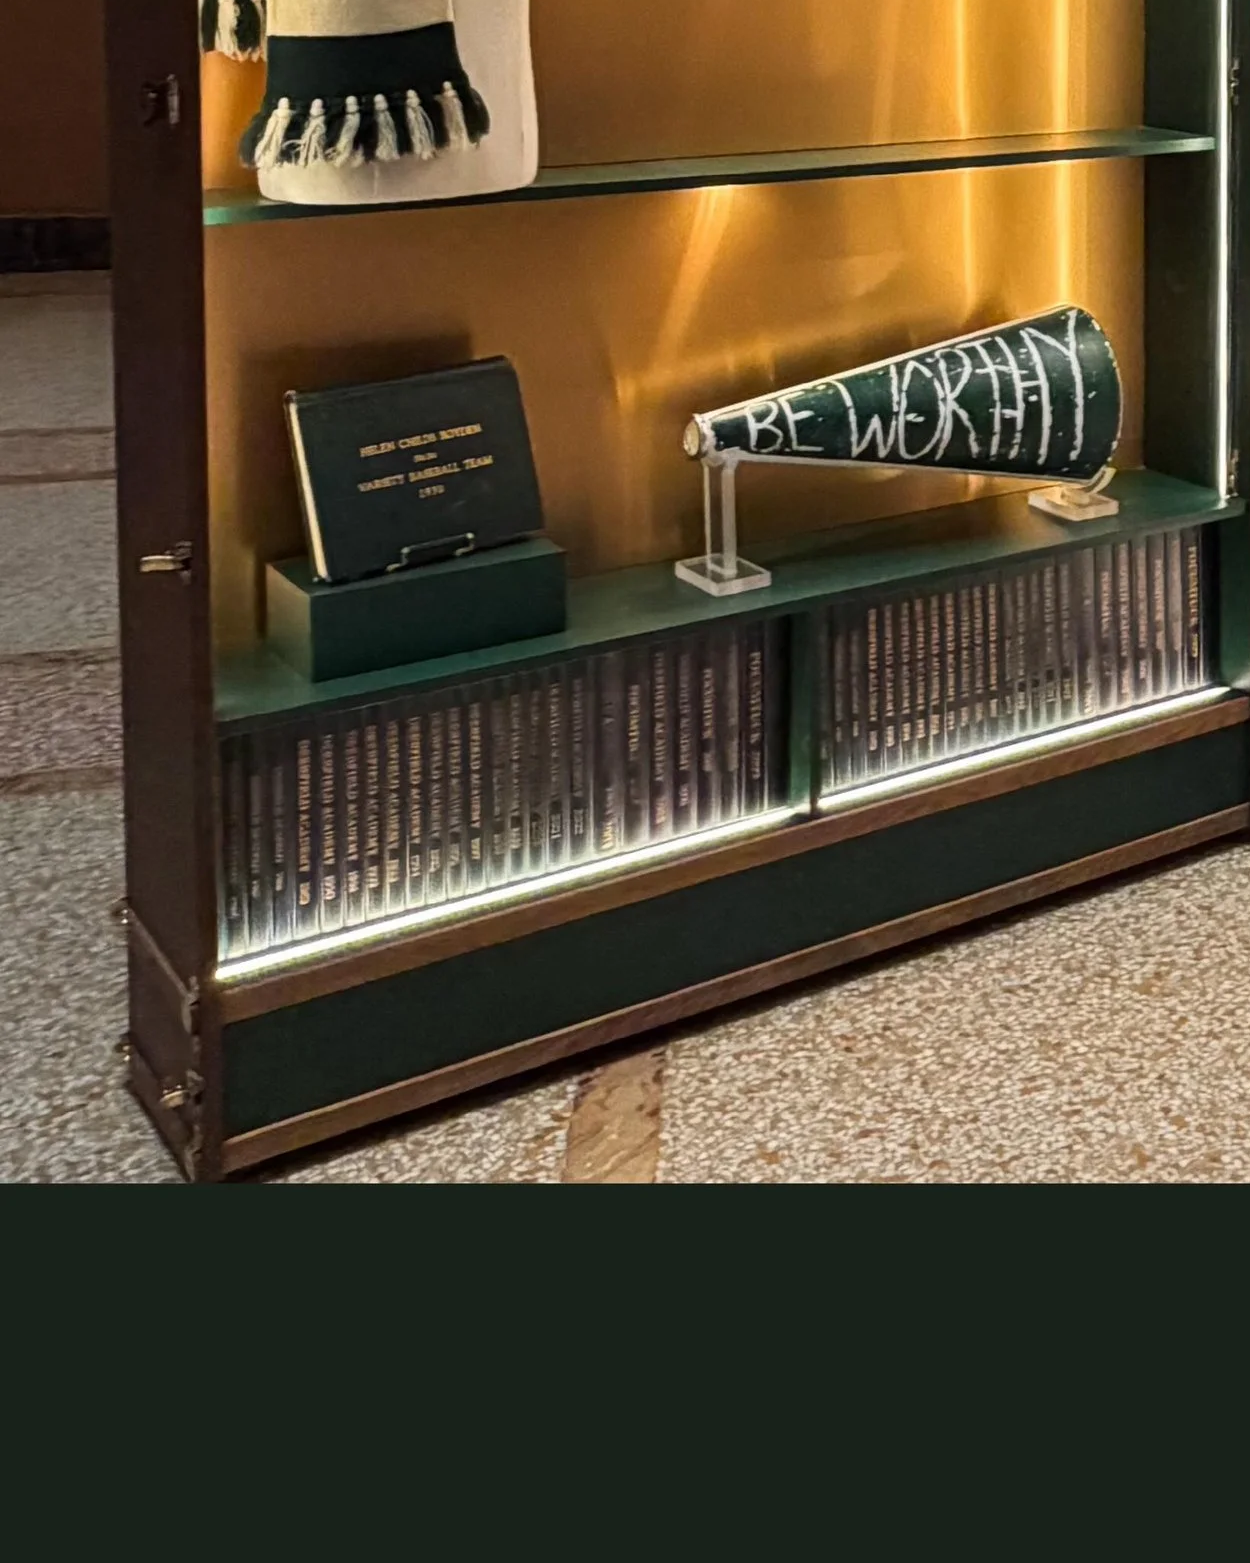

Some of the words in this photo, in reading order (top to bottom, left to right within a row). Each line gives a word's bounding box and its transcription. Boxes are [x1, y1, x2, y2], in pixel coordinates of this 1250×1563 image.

[744, 385, 824, 454] BE
[832, 309, 1085, 466] WORTHY
[462, 454, 494, 471] TEAM
